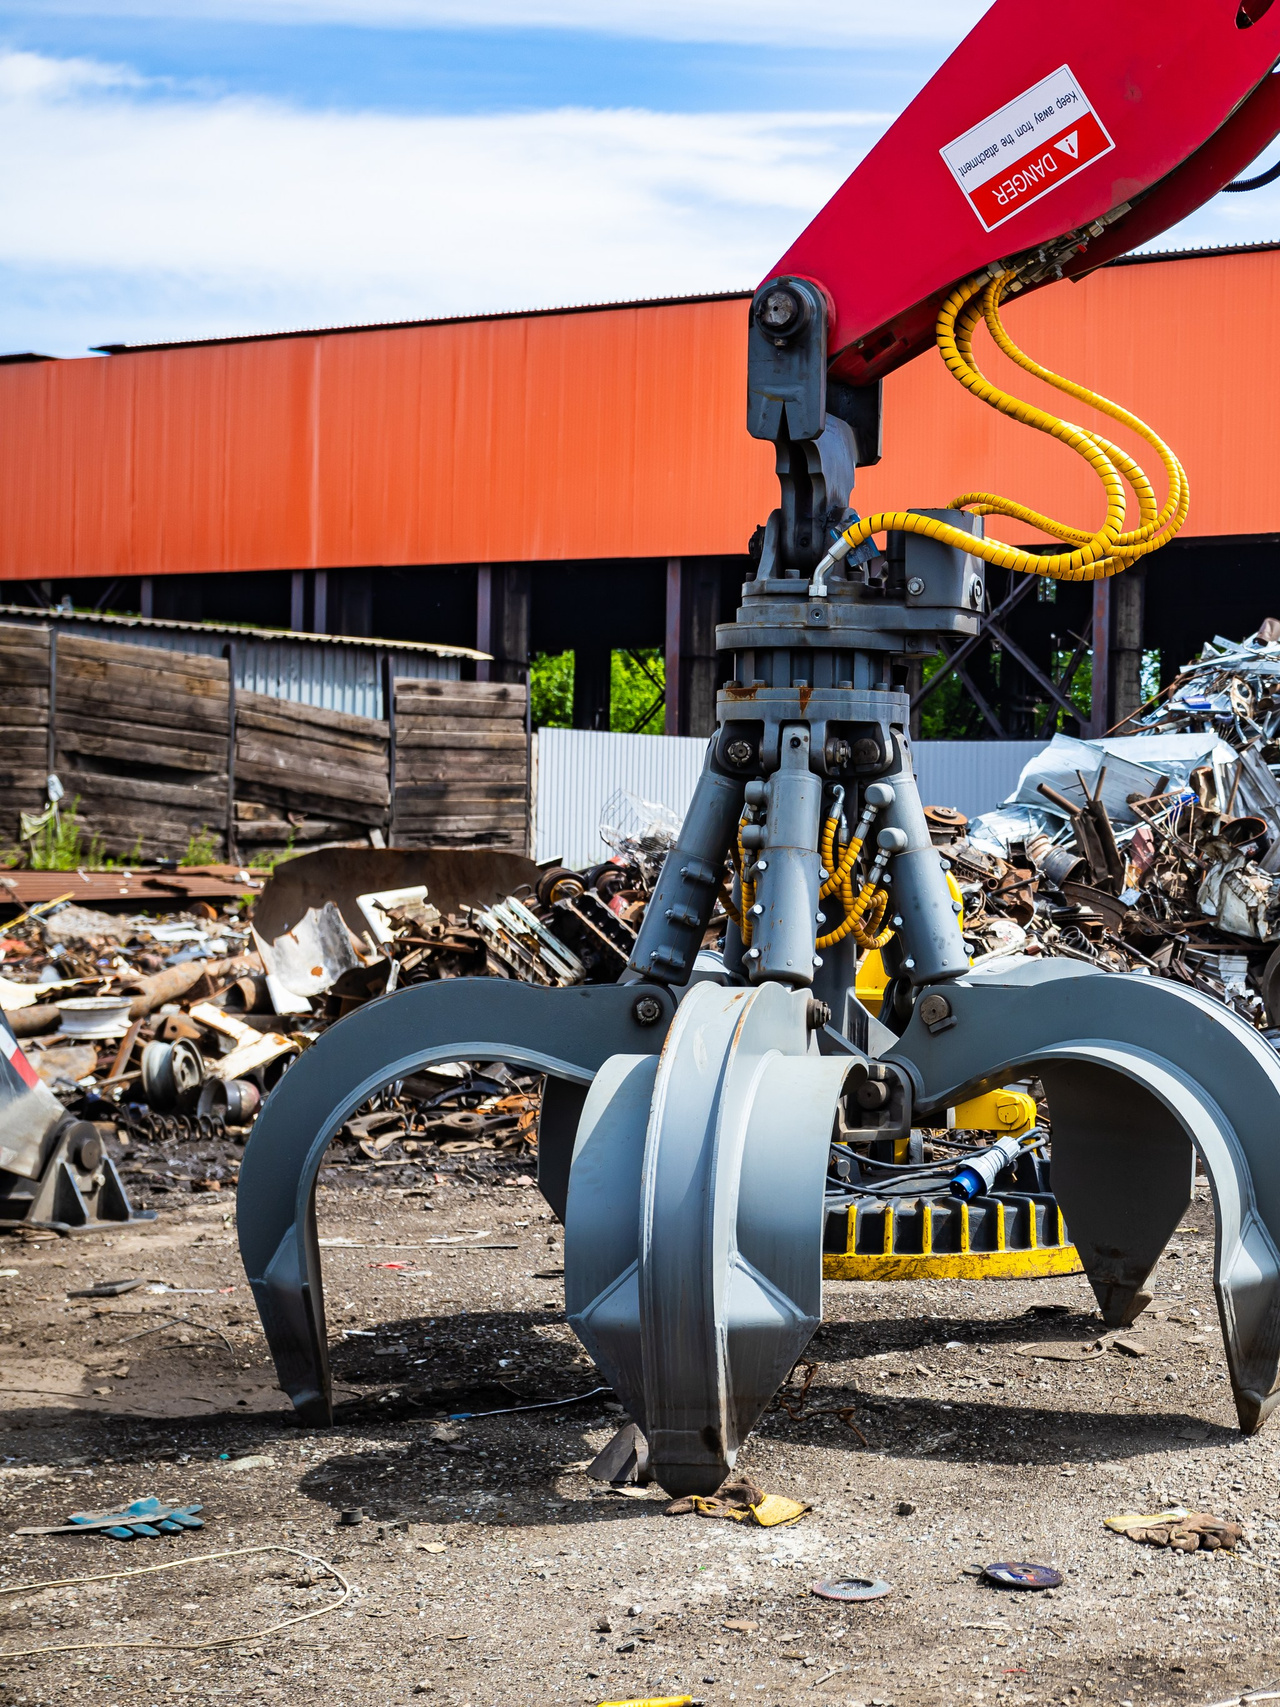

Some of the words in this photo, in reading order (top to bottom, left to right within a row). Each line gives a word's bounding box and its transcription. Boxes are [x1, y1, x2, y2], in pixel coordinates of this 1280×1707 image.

[1056, 91, 1079, 109] Keep
[1033, 105, 1055, 125] away
[1014, 120, 1035, 138] from
[1000, 133, 1016, 147] the
[958, 143, 1000, 178] attachment
[992, 152, 1058, 205] DANGER
